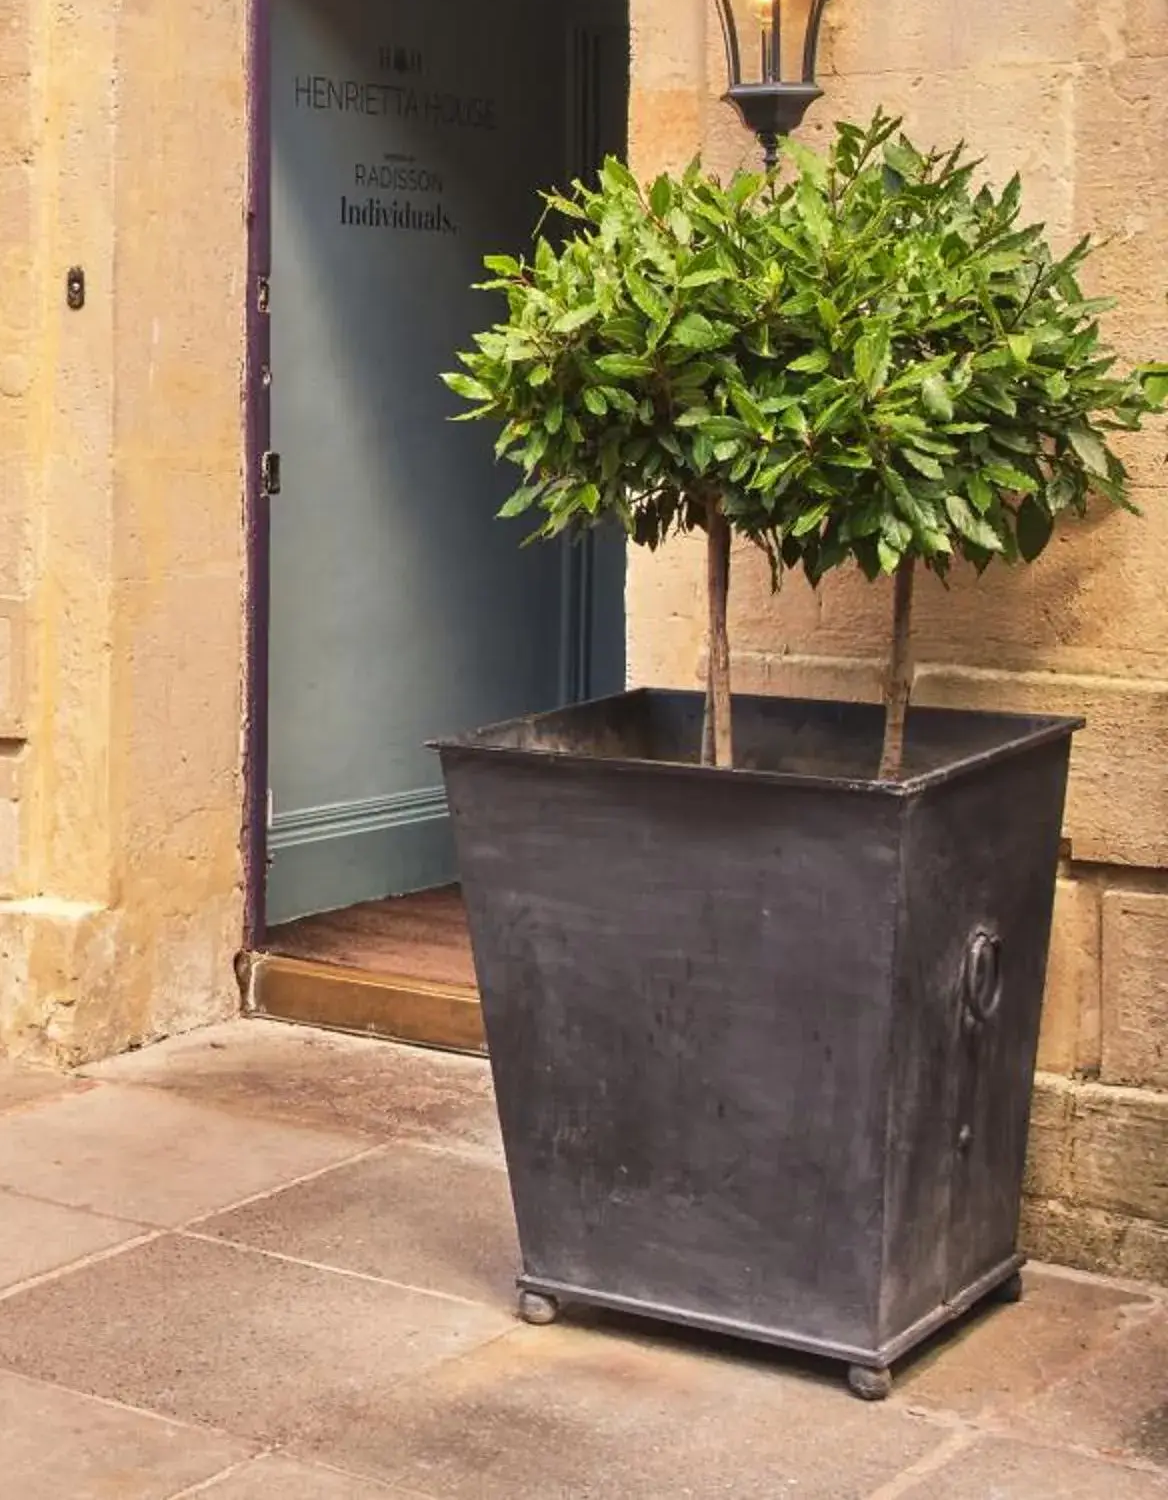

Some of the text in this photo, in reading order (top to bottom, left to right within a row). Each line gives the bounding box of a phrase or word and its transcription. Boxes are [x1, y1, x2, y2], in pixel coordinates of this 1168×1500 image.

[295, 75, 497, 130] HENRIETTA HOUSE
[355, 164, 444, 193] RADISSON
[340, 195, 460, 236] Individuals.
